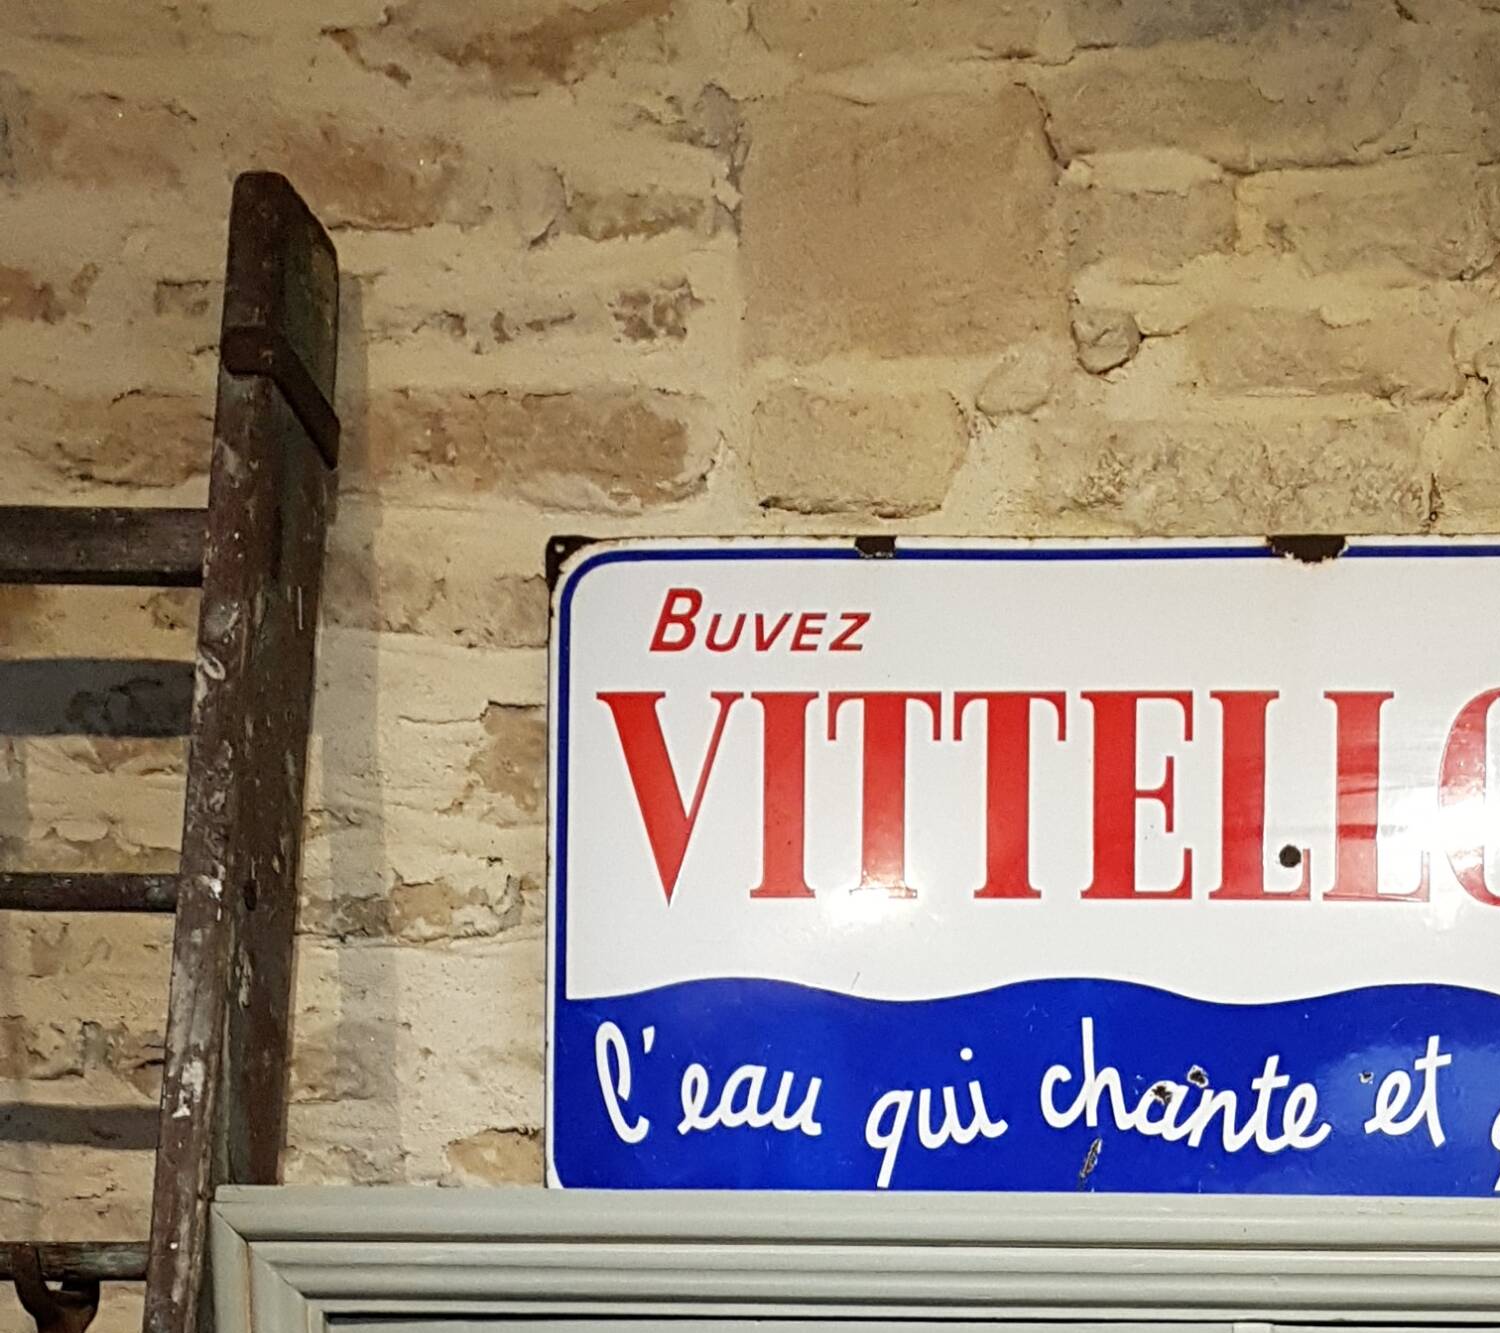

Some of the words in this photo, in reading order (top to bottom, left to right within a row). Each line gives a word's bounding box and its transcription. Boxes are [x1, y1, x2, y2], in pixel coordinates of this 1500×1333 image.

[595, 1021, 822, 1144] l'eau
[865, 1048, 1008, 1189] qui
[1039, 1017, 1331, 1154] chante
[1364, 1035, 1452, 1147] et
